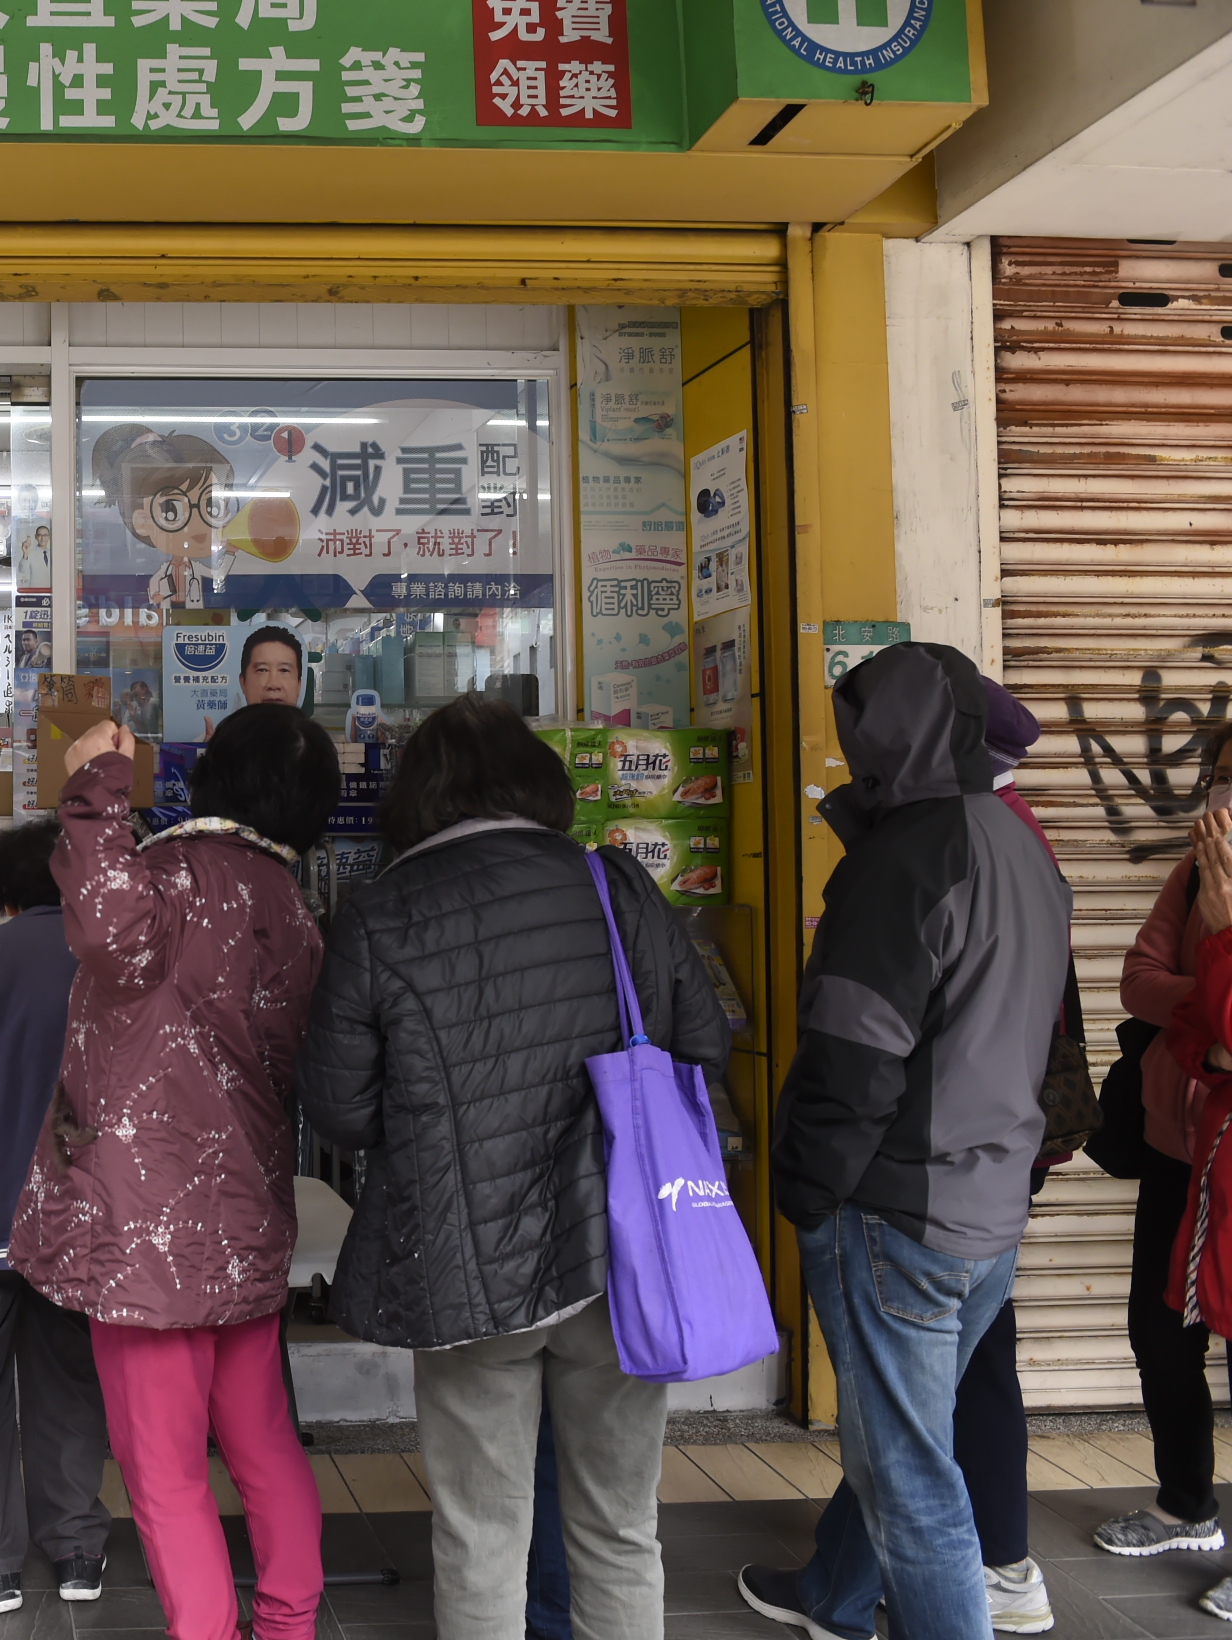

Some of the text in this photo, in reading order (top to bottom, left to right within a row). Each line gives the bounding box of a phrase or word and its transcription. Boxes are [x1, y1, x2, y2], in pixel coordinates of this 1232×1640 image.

[489, 0, 615, 44] 免費
[766, 0, 808, 55] TIONAL
[813, 50, 875, 70] HEALTH
[490, 58, 619, 119] 領藥
[618, 346, 676, 365] 淨脈舒
[308, 440, 472, 519] 減重
[478, 442, 520, 518] 配對
[390, 581, 521, 600] 專業諮詢請內洽
[587, 577, 682, 618] 循利寧
[175, 631, 225, 643] Fresubin
[832, 625, 901, 642] 北安路
[184, 644, 217, 656] 倍速益
[173, 675, 229, 685] 營養補充配方
[190, 688, 228, 698] 大直藥局
[195, 699, 228, 711] 黃藥師
[618, 753, 671, 772] 五月花
